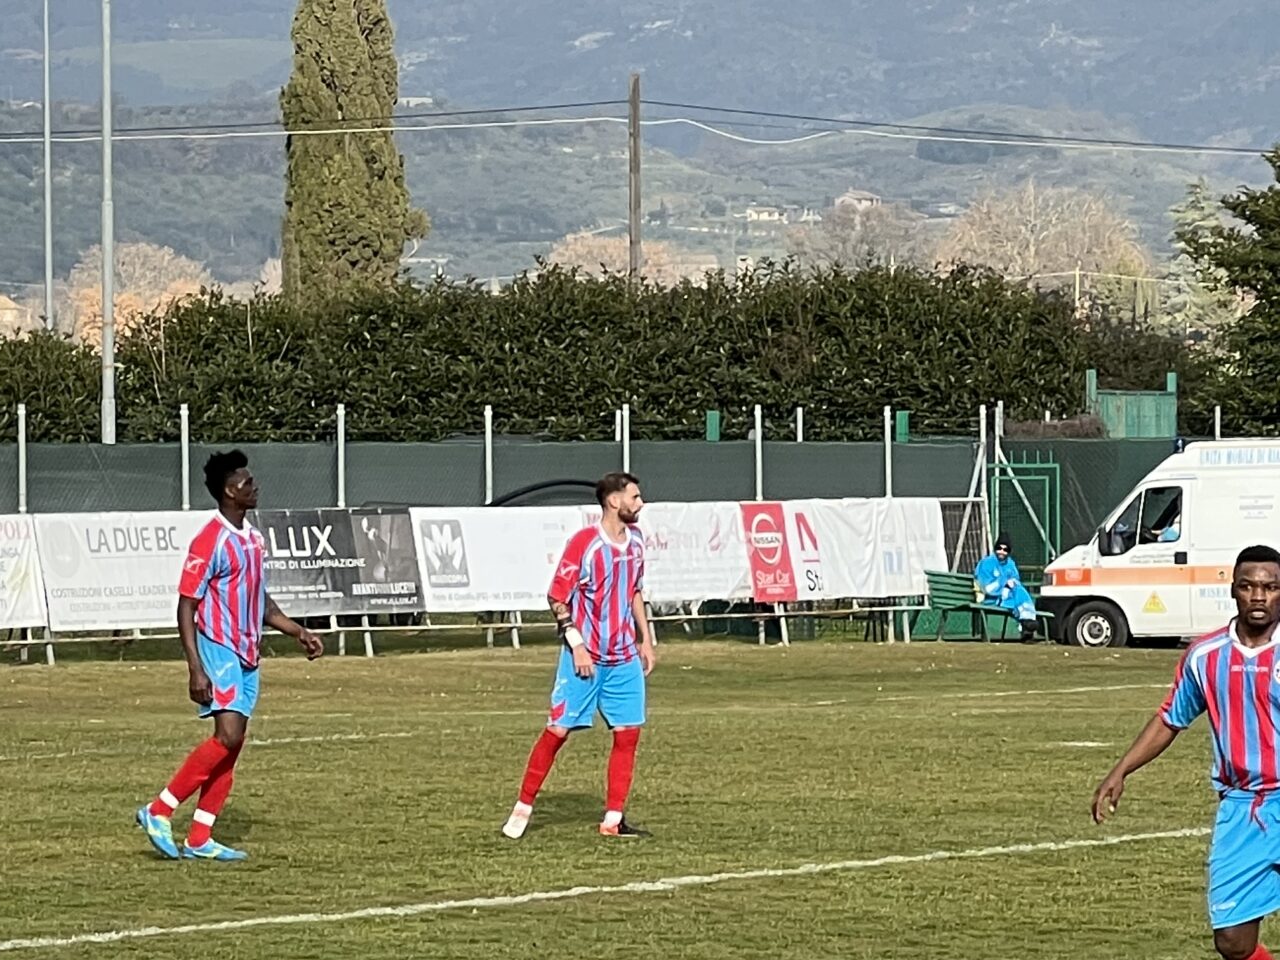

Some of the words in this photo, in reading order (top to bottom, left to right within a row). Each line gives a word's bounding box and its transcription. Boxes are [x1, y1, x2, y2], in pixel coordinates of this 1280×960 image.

[86, 528, 111, 553] LA
[113, 527, 152, 552] DUE
[155, 526, 180, 551] BC
[264, 525, 336, 557] LUX
[753, 536, 781, 544] NISSAN
